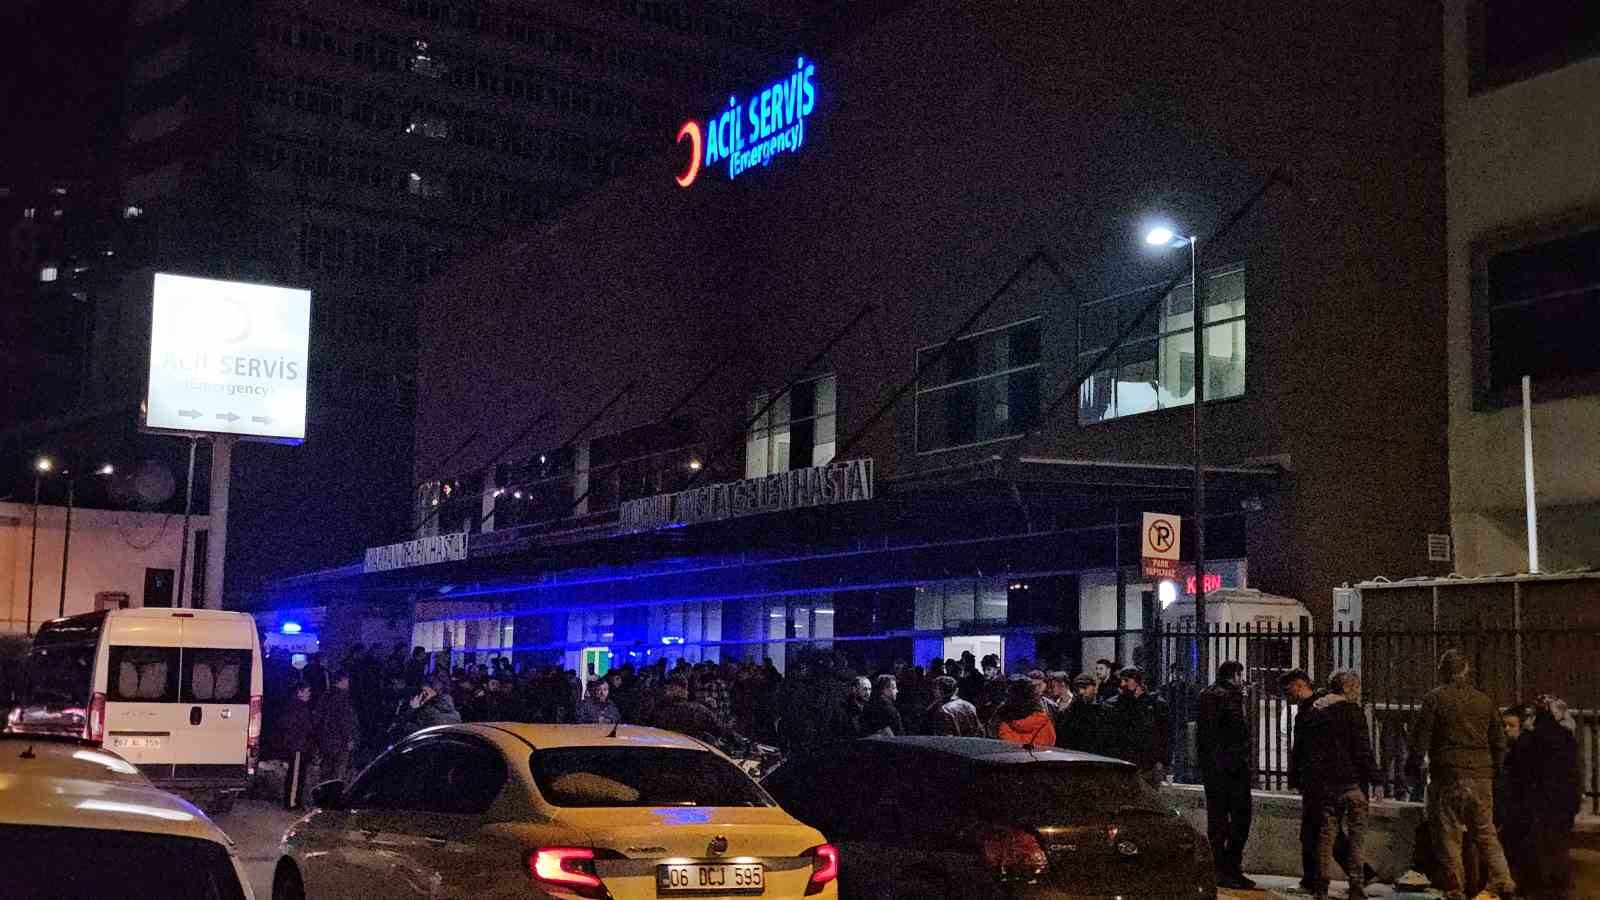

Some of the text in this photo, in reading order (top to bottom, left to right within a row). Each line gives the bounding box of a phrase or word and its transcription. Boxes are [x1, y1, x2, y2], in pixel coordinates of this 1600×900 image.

[706, 56, 816, 167] ACİL SERVİS
[729, 118, 804, 181] (Emergency)
[219, 354, 298, 380] SERVİS
[1186, 575, 1220, 594] KRN
[670, 867, 762, 887] 06 DCJ 595
